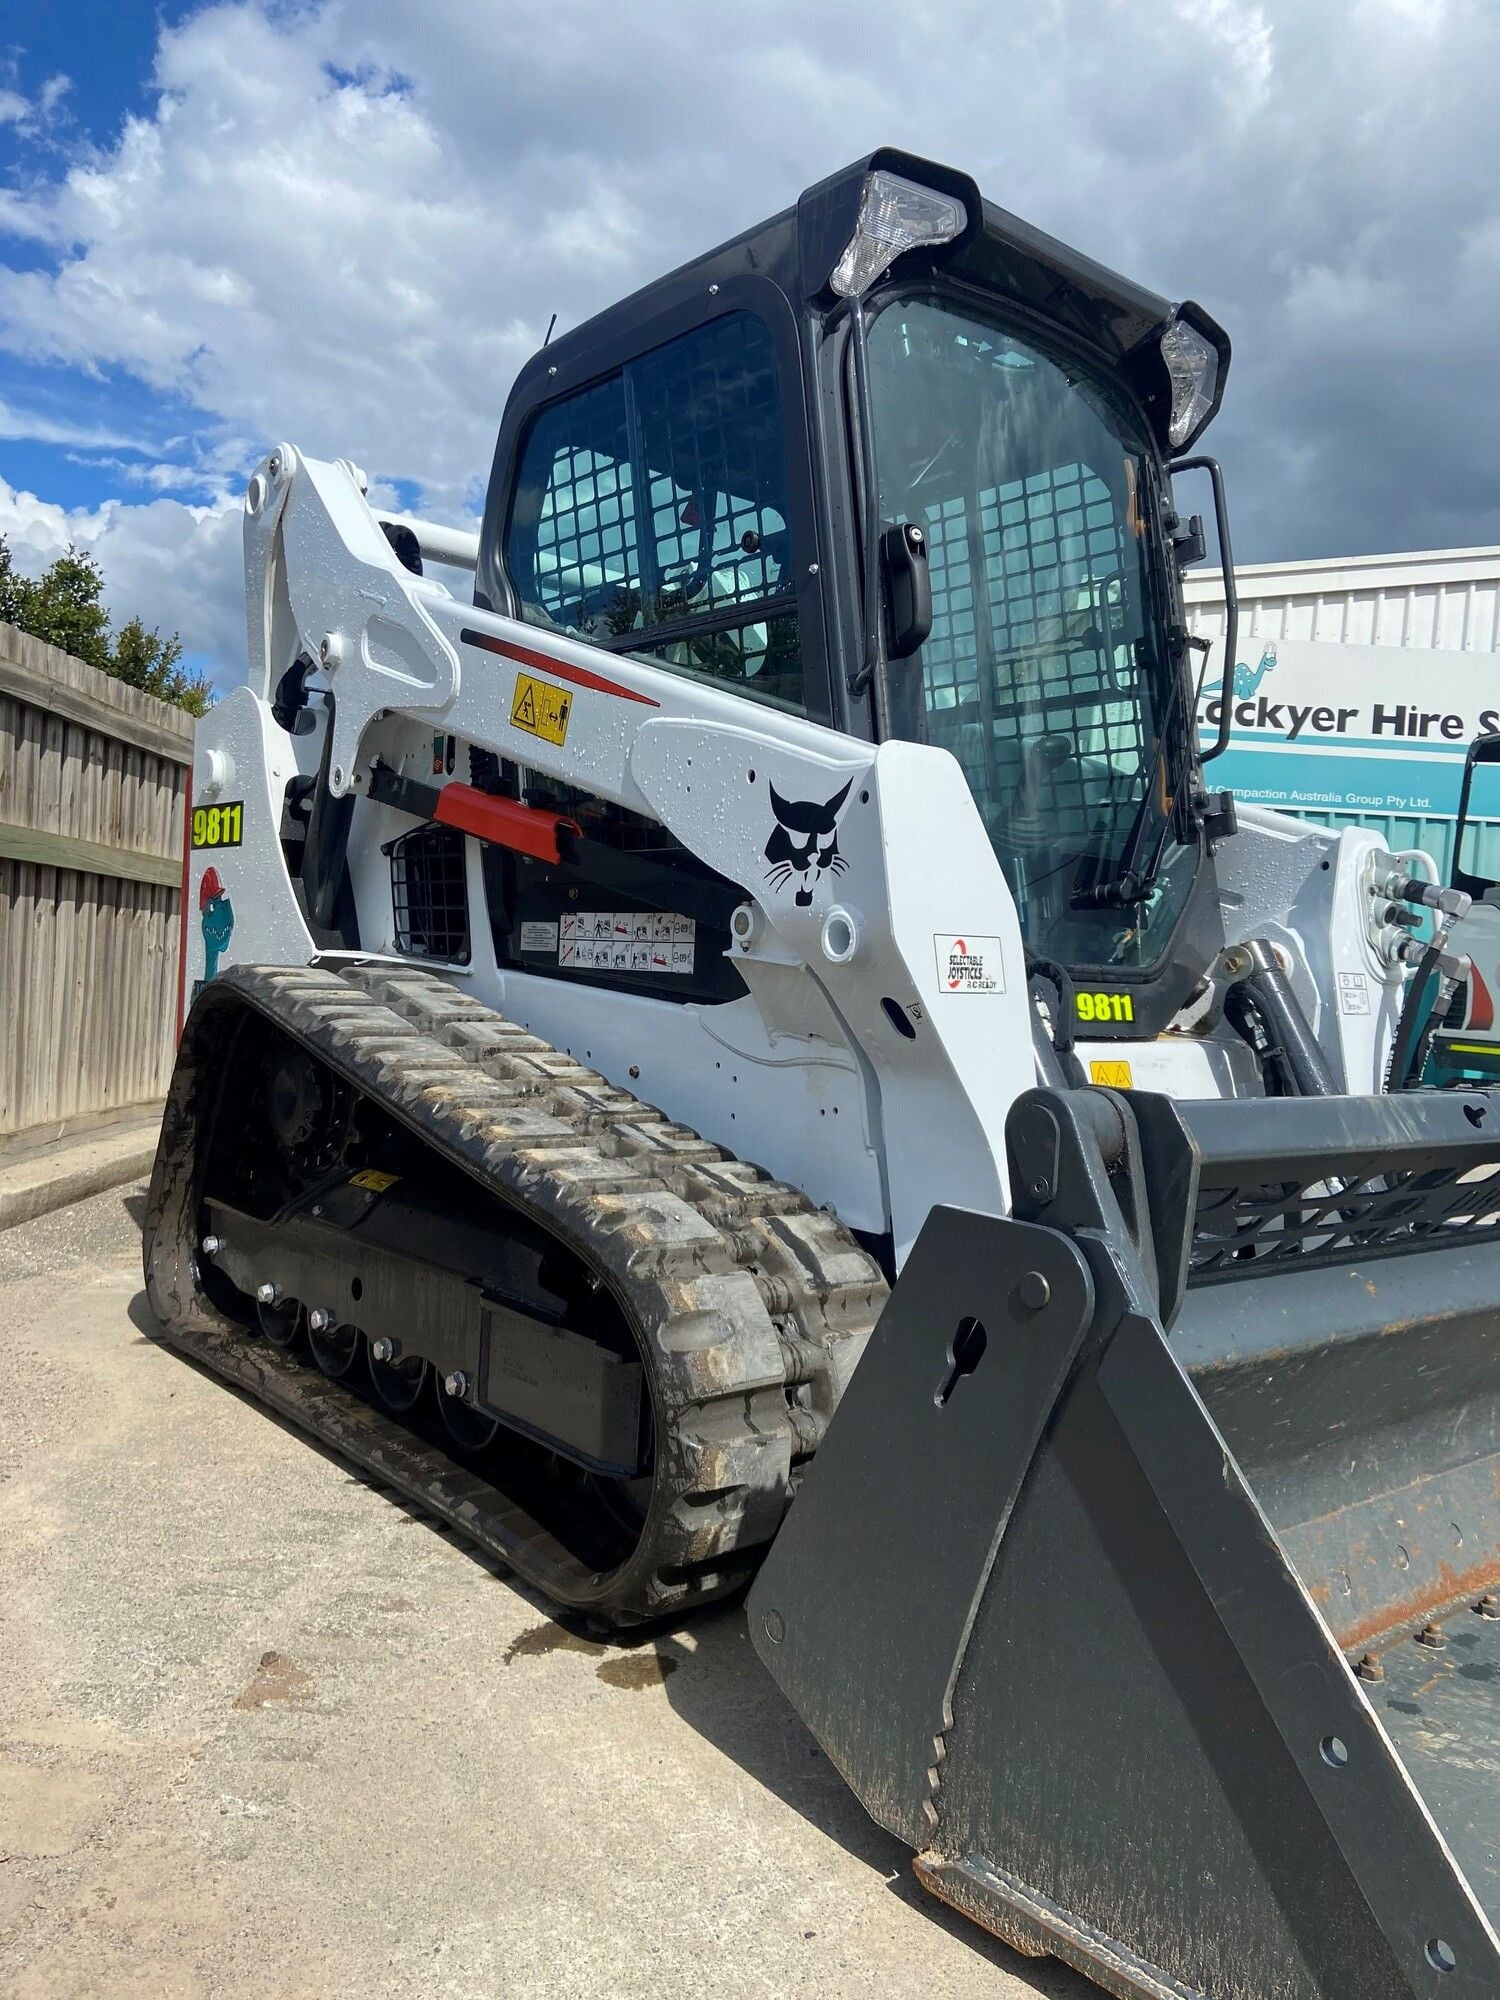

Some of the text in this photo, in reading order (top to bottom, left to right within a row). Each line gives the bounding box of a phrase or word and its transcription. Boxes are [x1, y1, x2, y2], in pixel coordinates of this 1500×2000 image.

[1197, 697, 1359, 740] ockyer
[1372, 703, 1464, 740] Hire
[1215, 785, 1287, 800] Cmpaction
[1289, 790, 1343, 803] Australia
[1345, 793, 1384, 807] Group
[1386, 795, 1407, 809] Pty
[1409, 797, 1433, 809] Ltd.
[193, 805, 241, 846] 9811
[947, 966, 983, 980] JOYSTICKS
[949, 954, 984, 967] SELECTABLE
[1076, 992, 1134, 1021] 9811
